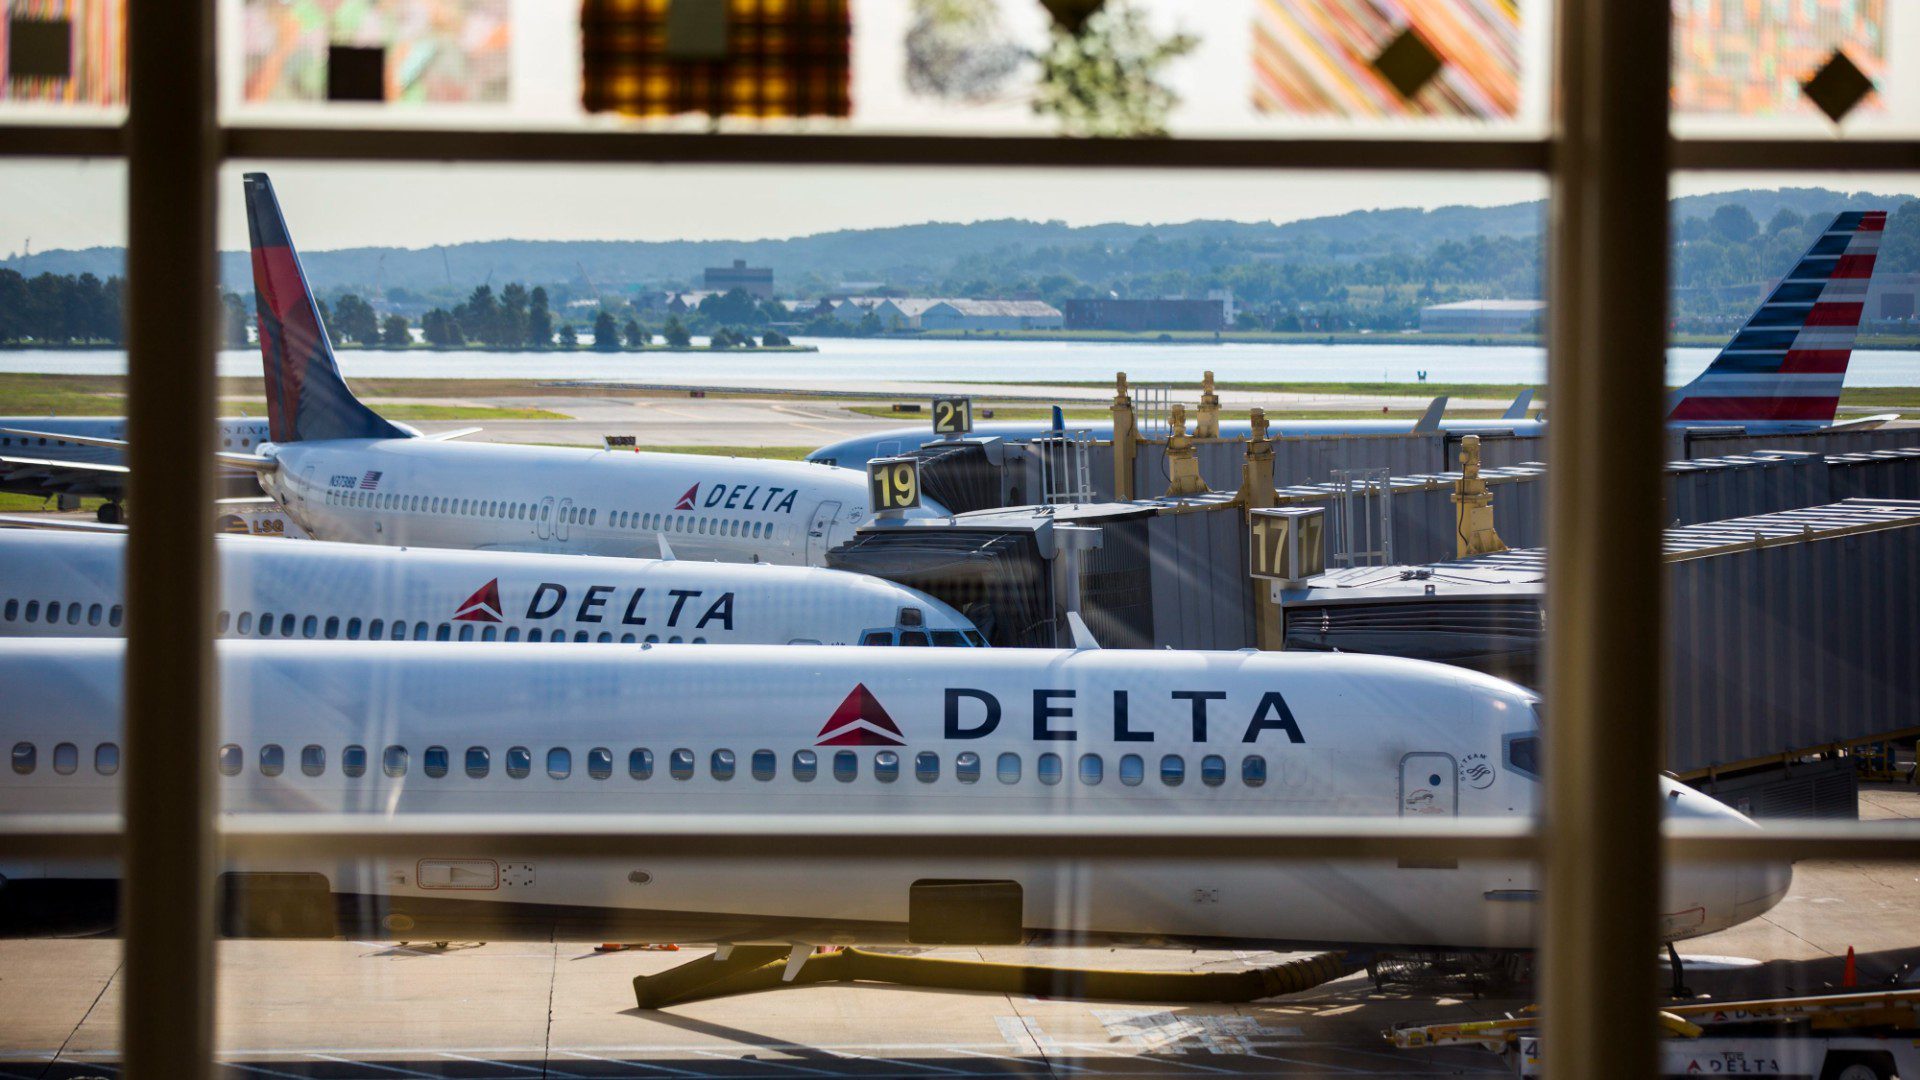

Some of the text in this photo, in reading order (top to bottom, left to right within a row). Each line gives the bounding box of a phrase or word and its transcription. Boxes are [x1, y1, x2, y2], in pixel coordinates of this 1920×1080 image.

[936, 401, 969, 432] 21
[704, 483, 798, 514] DELTA
[874, 463, 916, 507] 19
[253, 519, 284, 532] LSG
[1253, 516, 1288, 574] 17
[1299, 515, 1323, 573] 17
[526, 582, 735, 631] DELTA
[944, 688, 1306, 744] DELTA
[1710, 1059, 1780, 1072] DELTA
